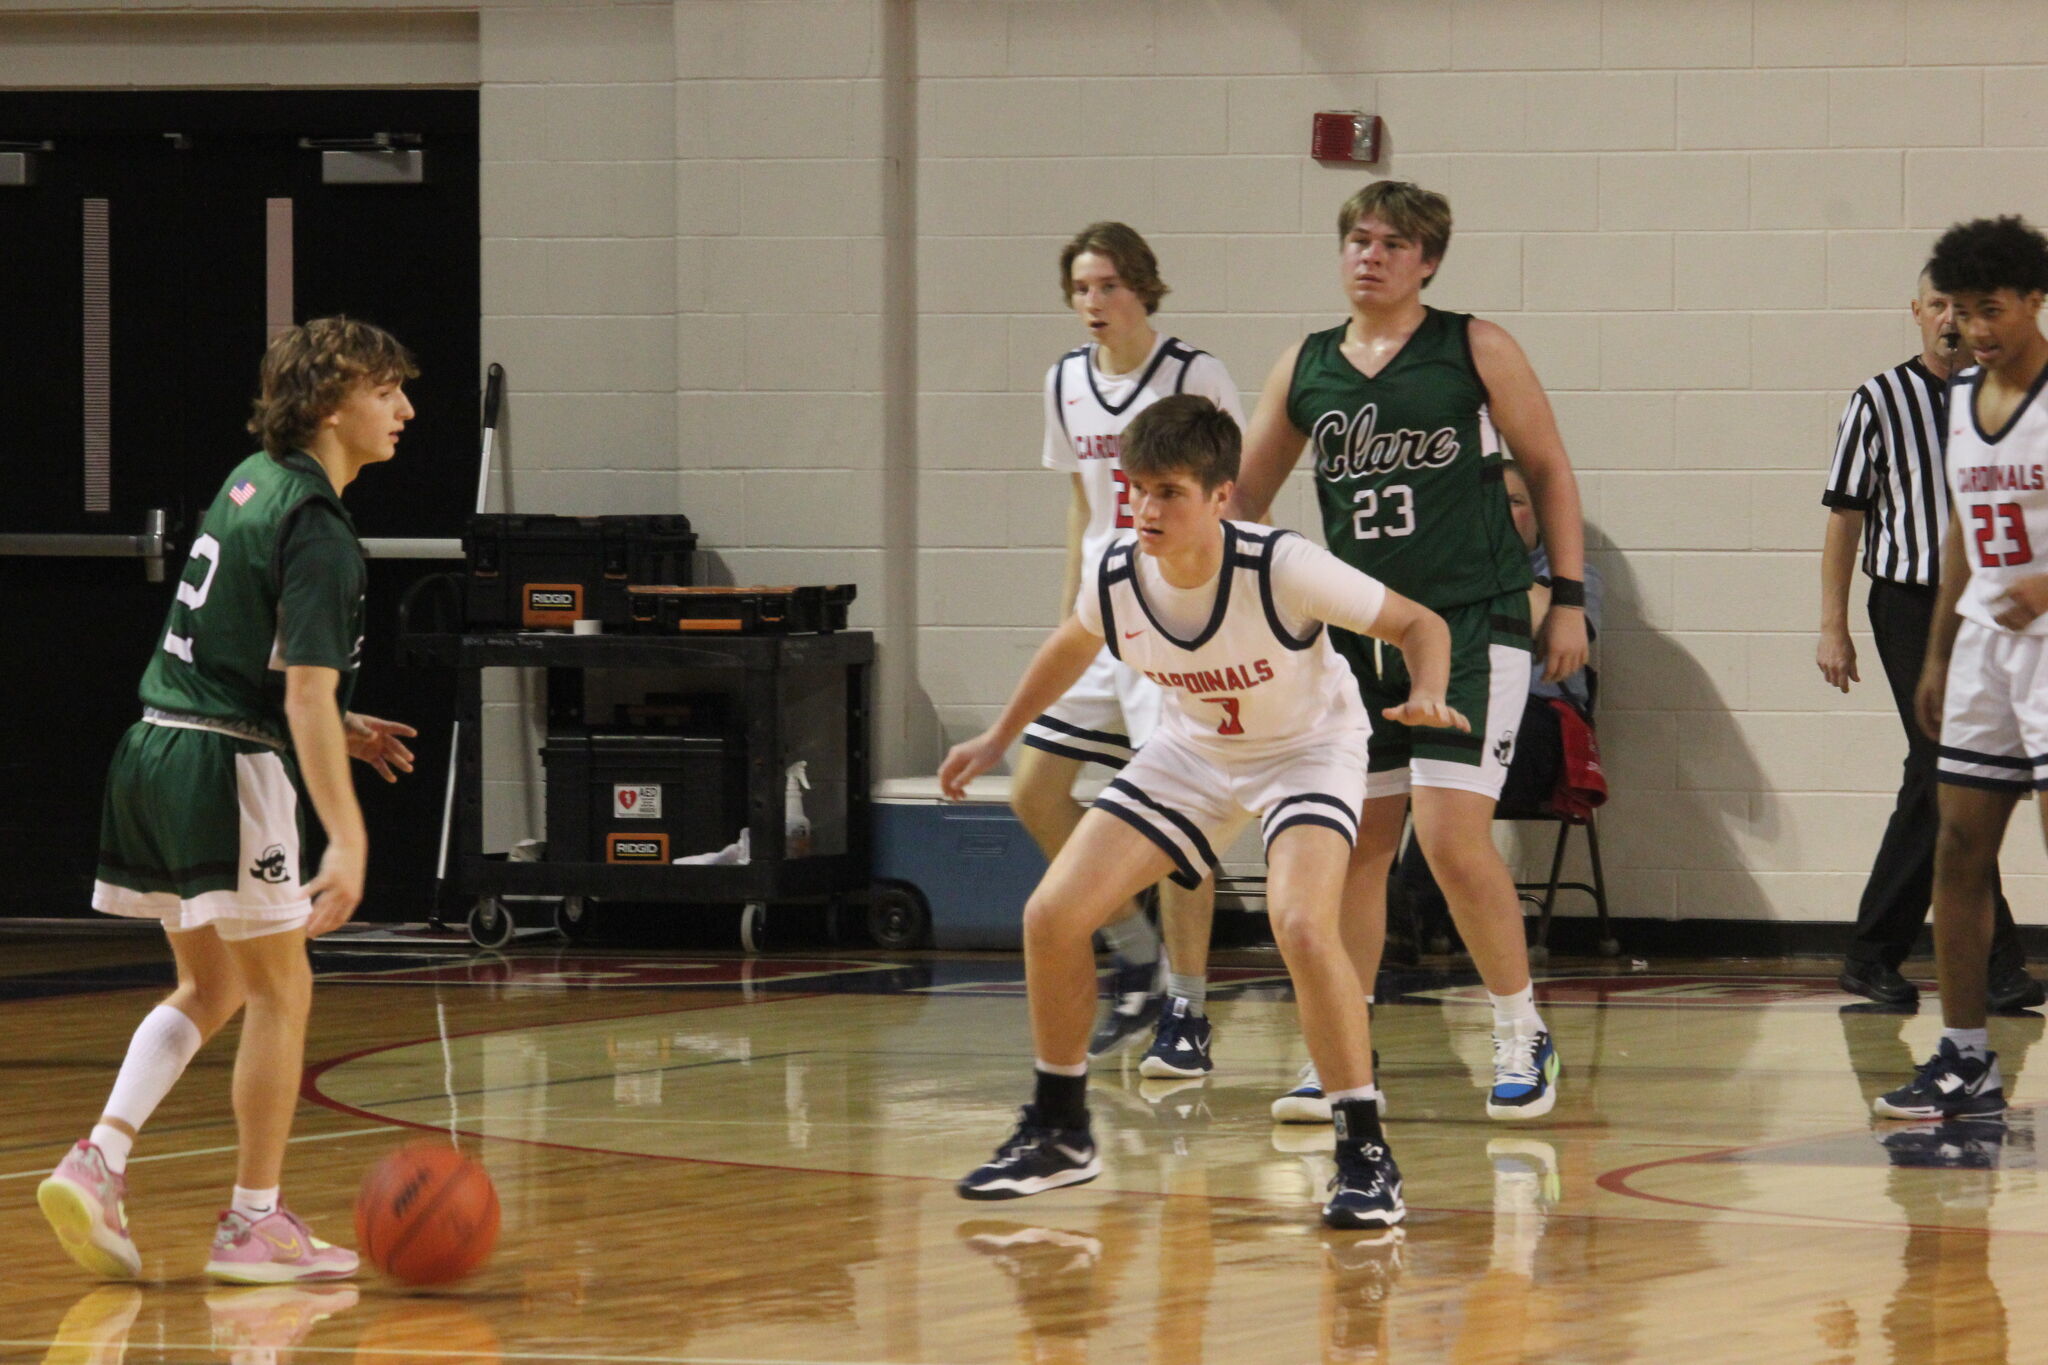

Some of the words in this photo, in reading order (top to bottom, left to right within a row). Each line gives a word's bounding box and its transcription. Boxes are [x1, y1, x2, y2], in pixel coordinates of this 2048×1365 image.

[1311, 403, 1460, 482] Clare
[1957, 464, 2044, 493] CARDINALS
[1353, 485, 1415, 539] 23
[1970, 502, 2033, 567] 23
[531, 593, 573, 604] RIDGID
[615, 843, 659, 854] RIDGID
